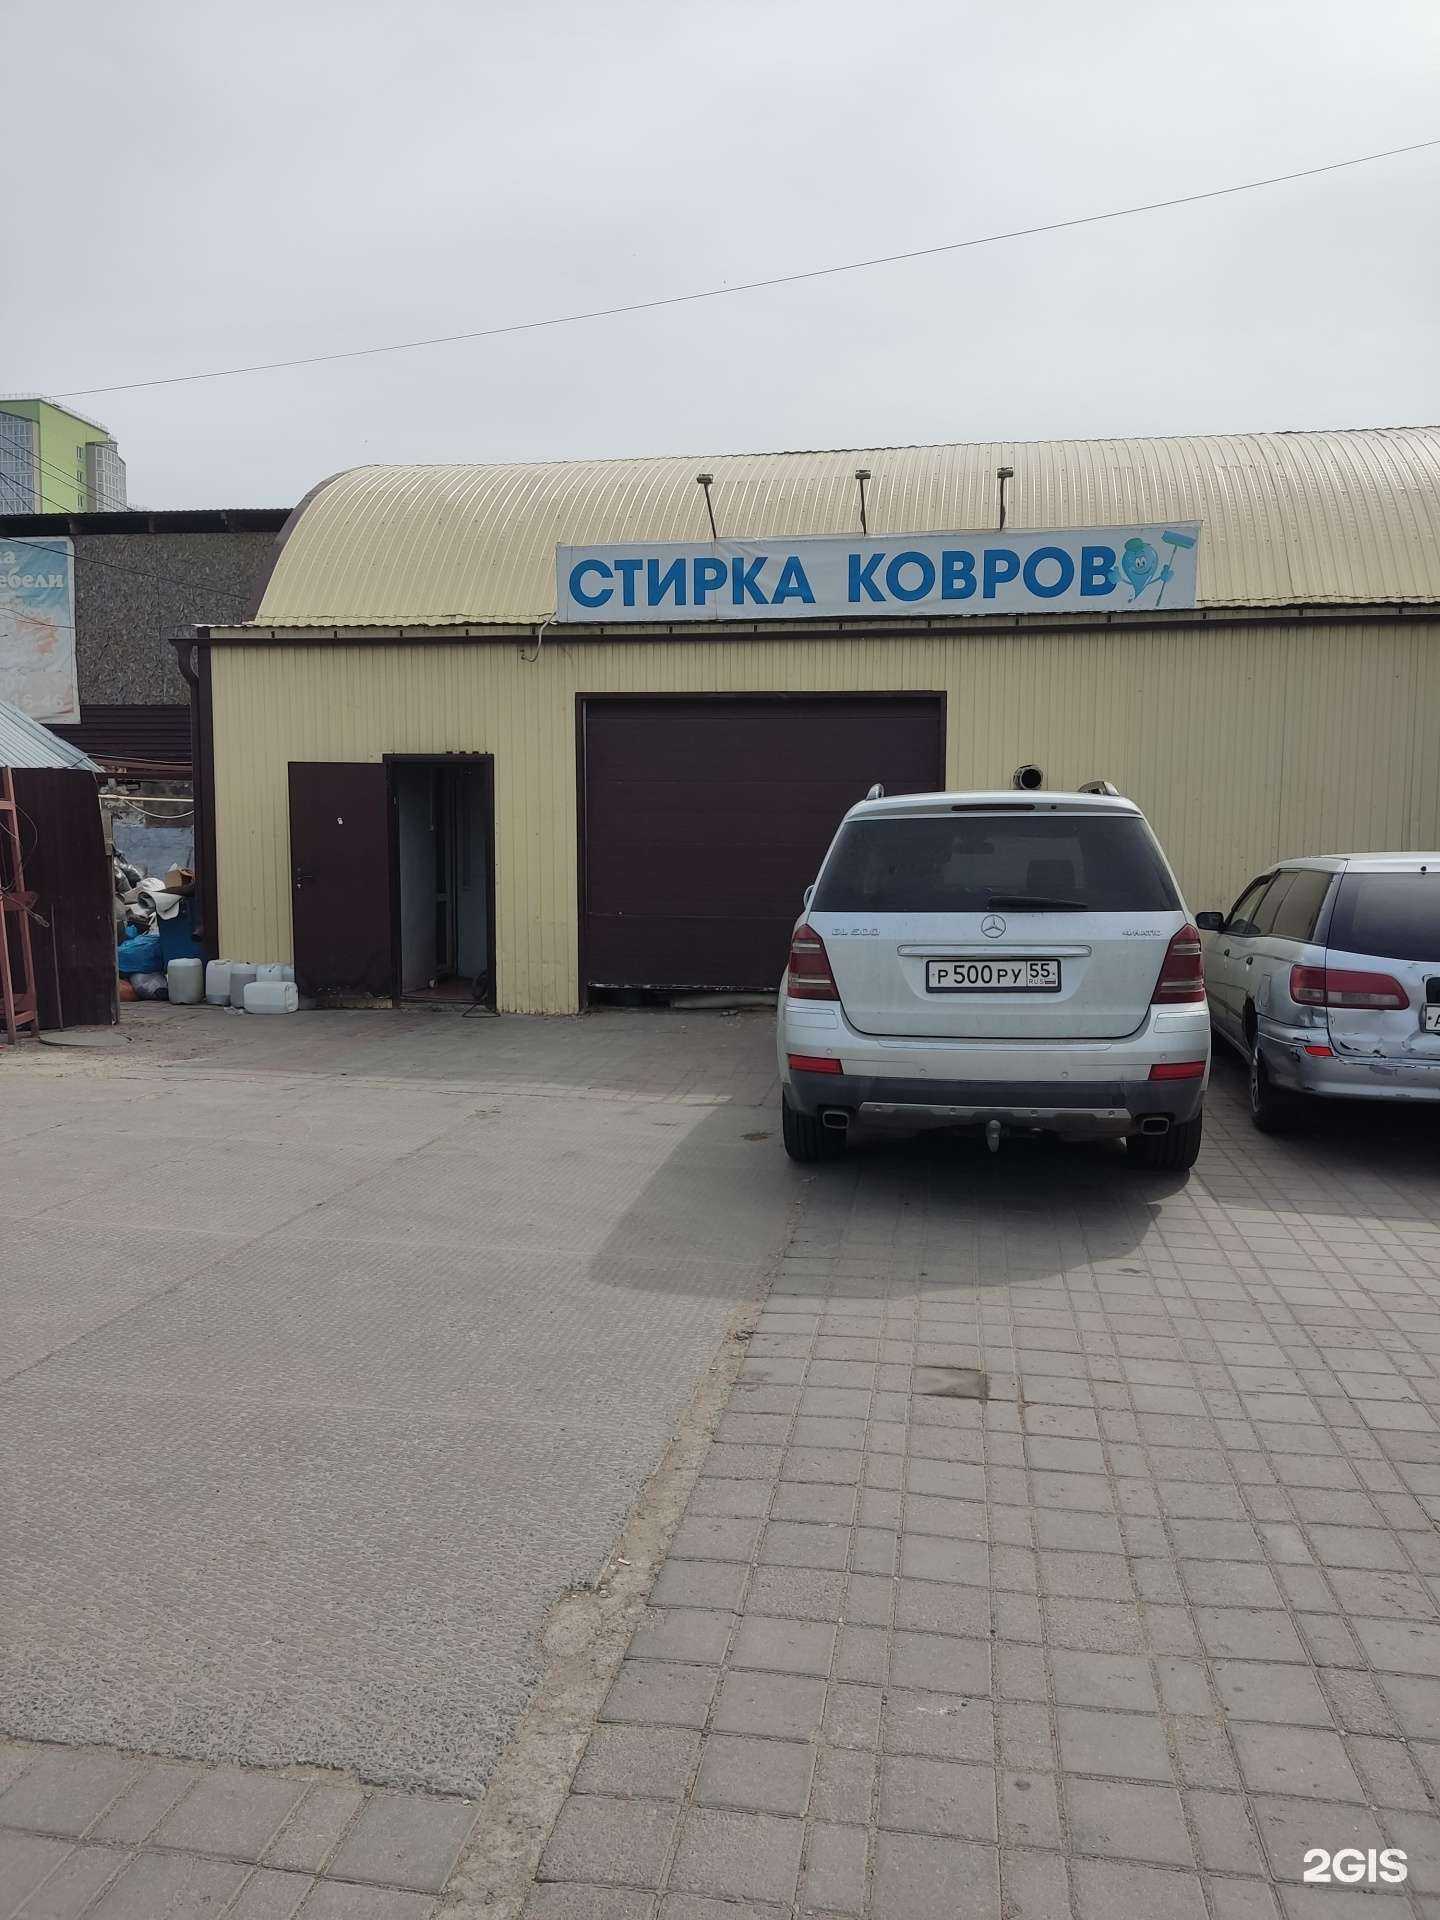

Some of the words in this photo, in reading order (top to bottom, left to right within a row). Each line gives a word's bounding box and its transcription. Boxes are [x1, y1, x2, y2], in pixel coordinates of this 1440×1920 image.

[0, 551, 16, 564] а
[569, 555, 816, 608] СТИРКА
[848, 545, 1118, 602] КОВРОВ
[1029, 963, 1050, 978] 55
